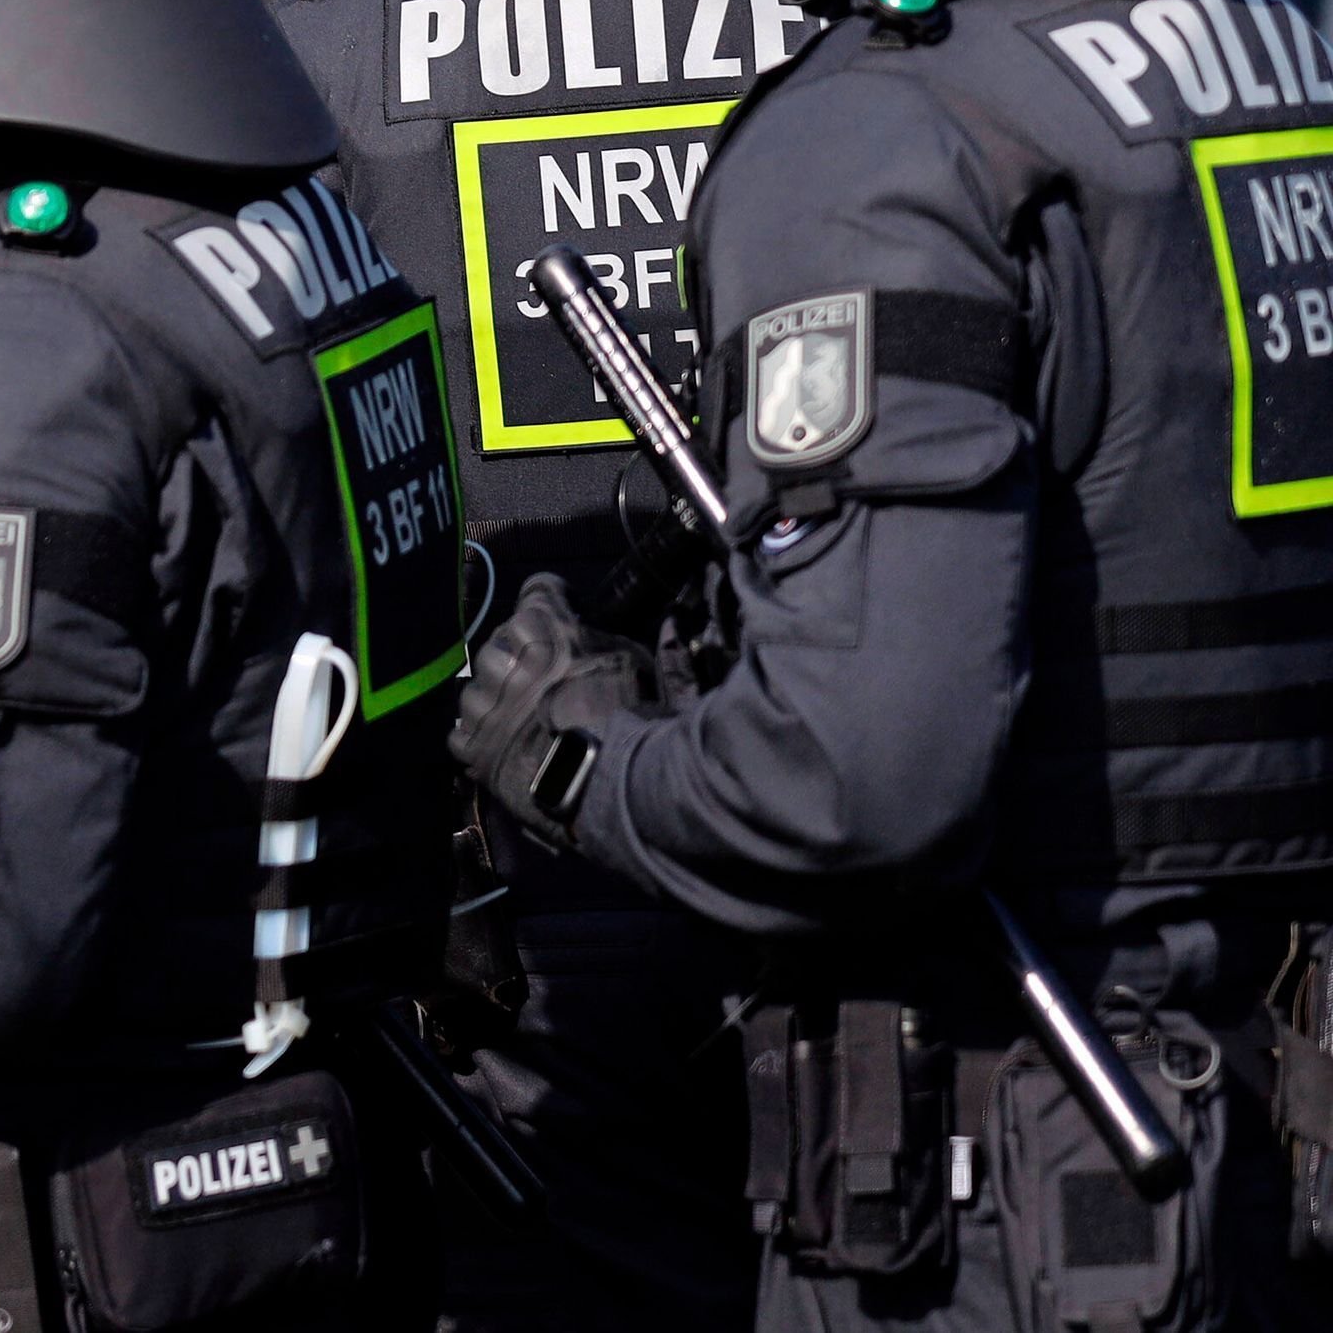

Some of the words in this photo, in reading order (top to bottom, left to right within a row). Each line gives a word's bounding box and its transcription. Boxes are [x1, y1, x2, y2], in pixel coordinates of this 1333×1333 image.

[755, 302, 856, 348] POLIZEI
[1257, 293, 1292, 363] 3
[1295, 285, 1333, 358] B
[349, 358, 425, 471] NRW
[366, 501, 390, 566] 3
[388, 478, 425, 555] BF
[428, 464, 452, 533] 11
[153, 1139, 283, 1205] POLIZEI
